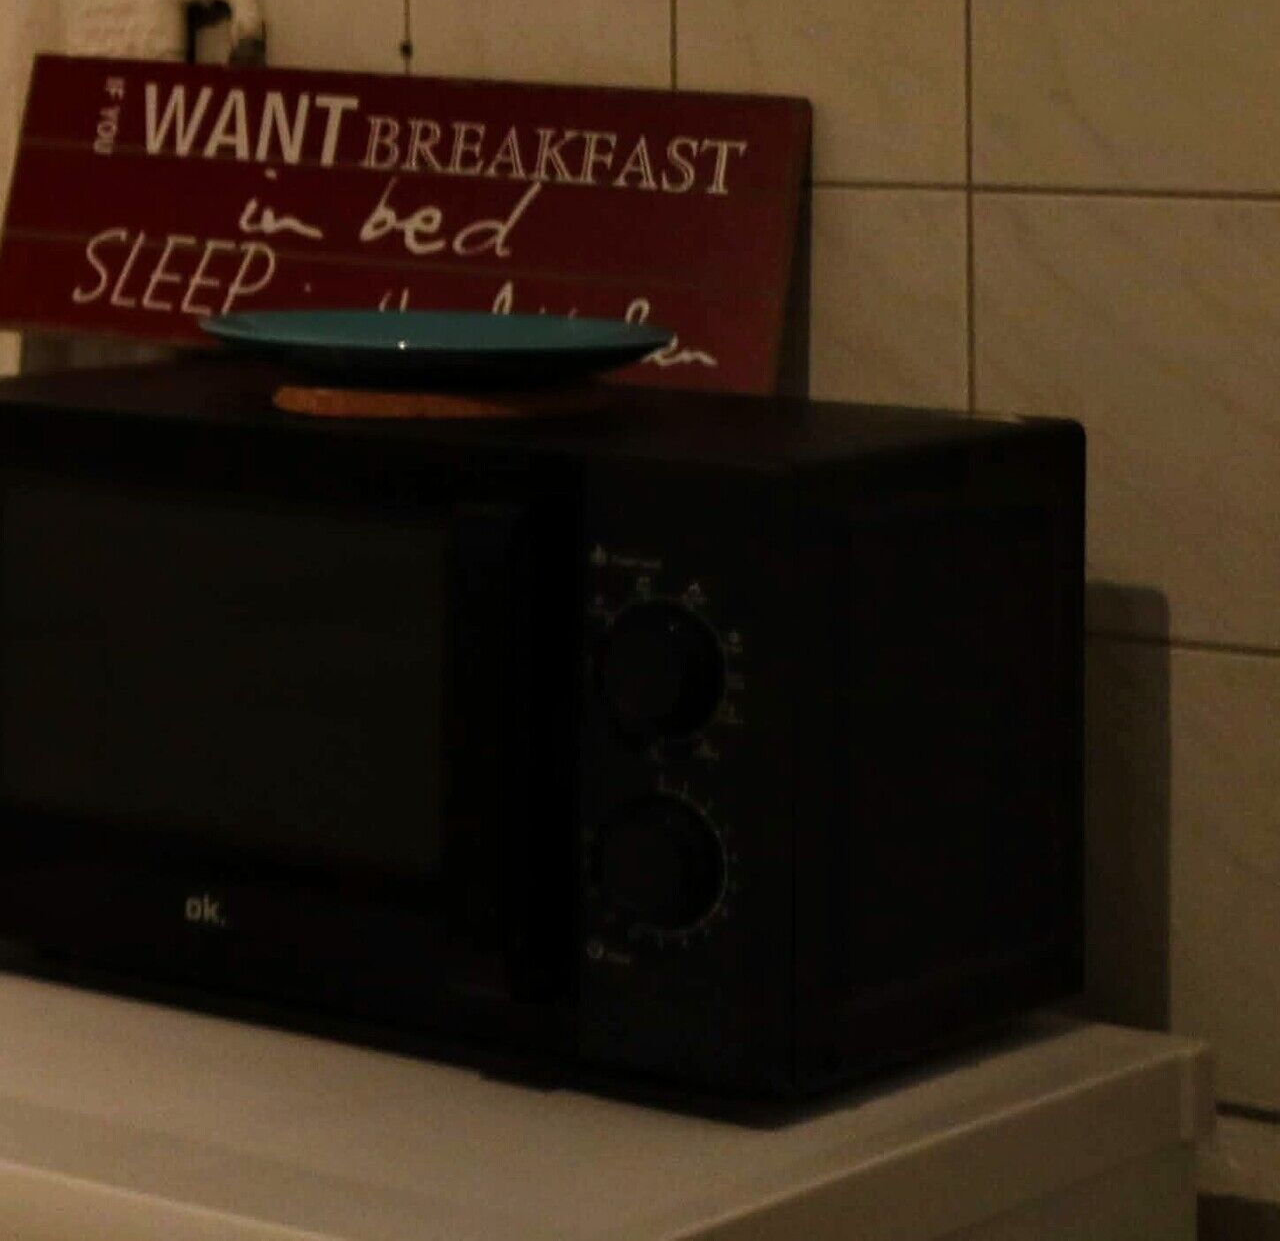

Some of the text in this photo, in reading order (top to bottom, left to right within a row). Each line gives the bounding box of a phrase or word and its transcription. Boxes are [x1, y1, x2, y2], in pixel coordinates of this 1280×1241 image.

[143, 80, 748, 197] WANT BREAKFAST
[239, 165, 543, 259] in bed
[70, 226, 277, 318] SLEEP
